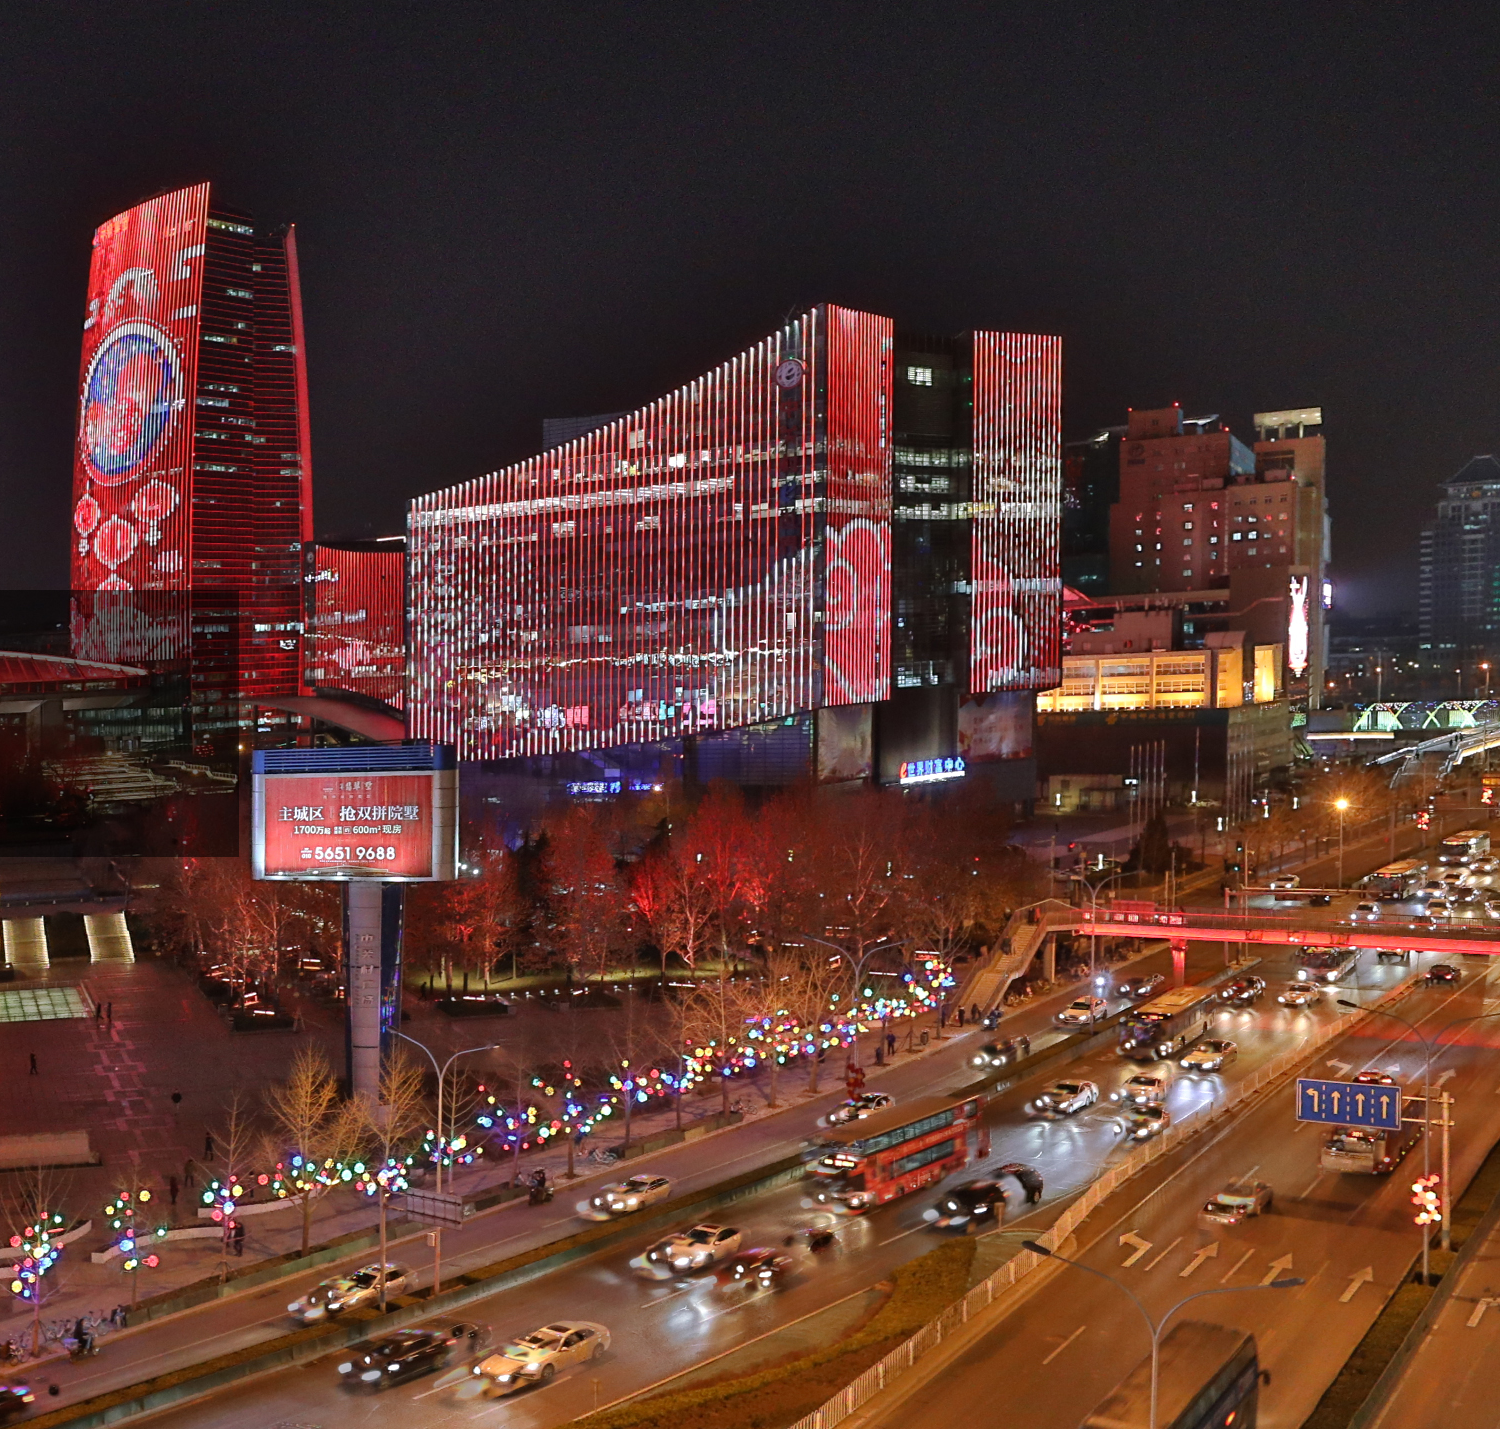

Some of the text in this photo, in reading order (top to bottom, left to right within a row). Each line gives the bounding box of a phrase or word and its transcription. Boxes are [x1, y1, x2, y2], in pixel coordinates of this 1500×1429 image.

[899, 756, 965, 779] e世界财富中心
[278, 805, 420, 822] 主城区 抢双拼院墅
[382, 824, 402, 834] 现房
[314, 846, 350, 861] 5651
[356, 846, 396, 861] 9688
